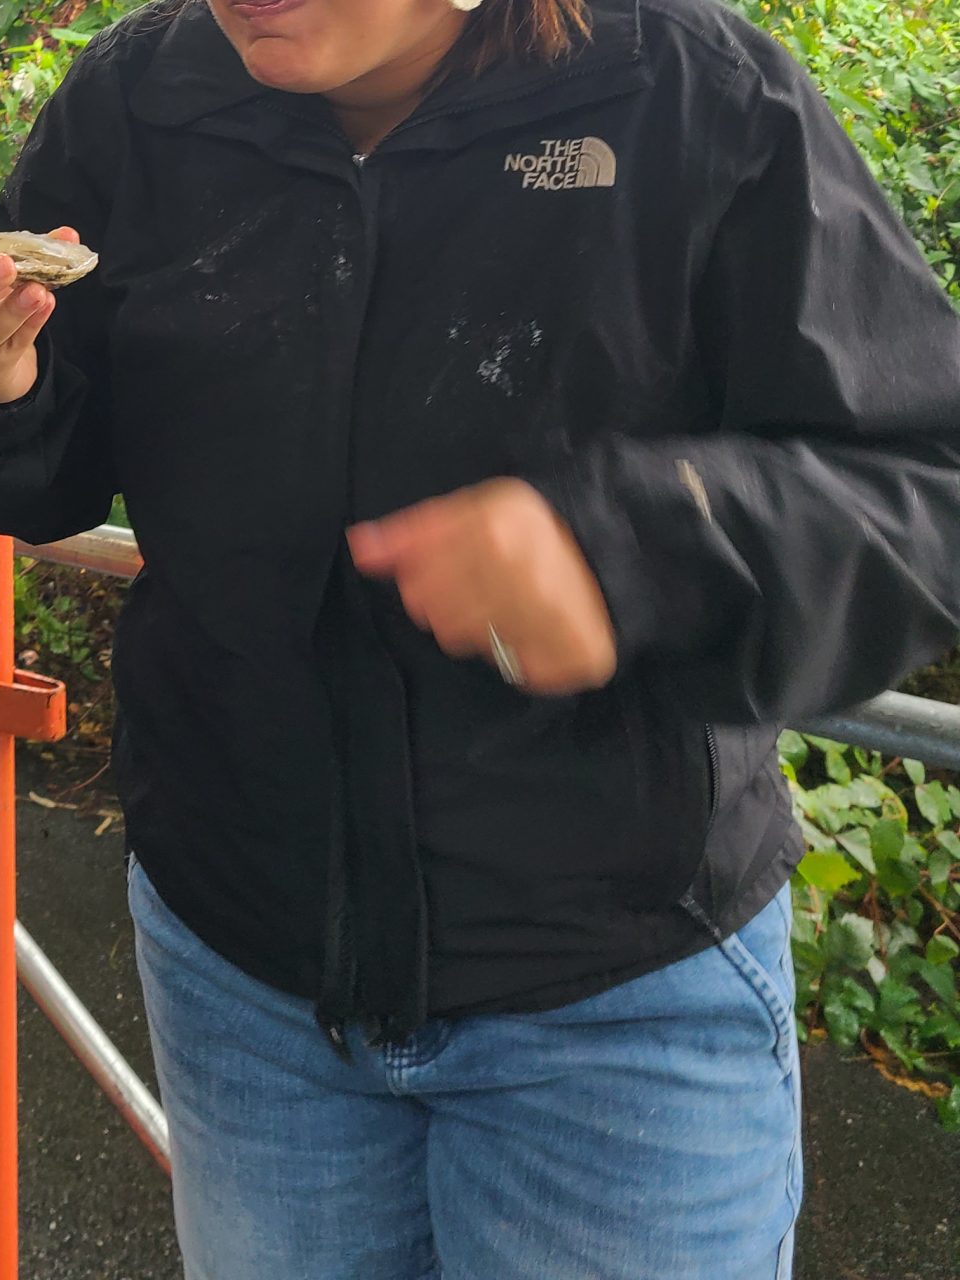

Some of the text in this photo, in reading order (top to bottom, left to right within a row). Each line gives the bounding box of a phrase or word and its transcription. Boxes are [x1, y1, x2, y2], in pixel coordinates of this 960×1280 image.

[540, 139, 582, 156] THE
[504, 154, 581, 172] NORTH
[522, 172, 577, 190] FACE
